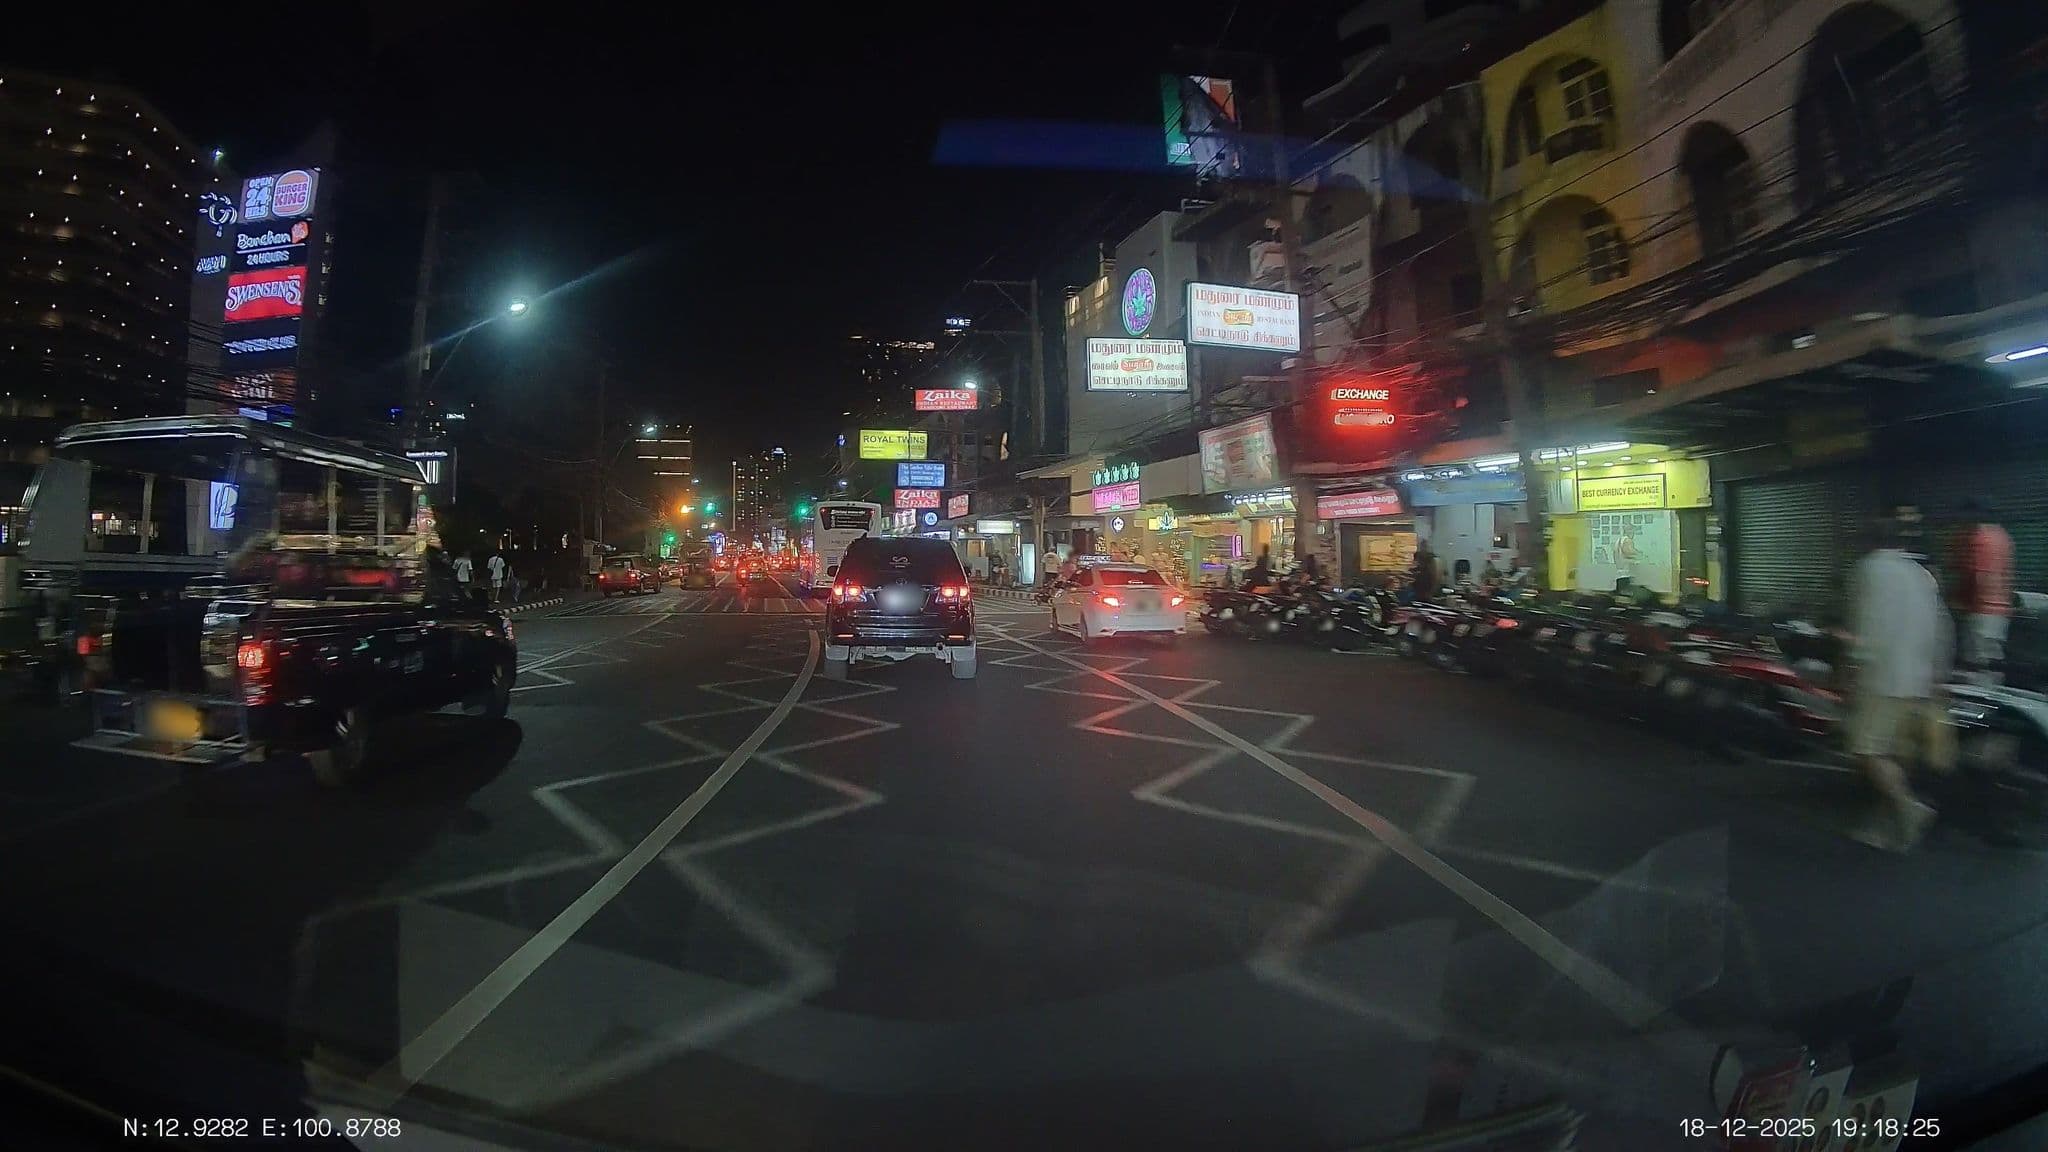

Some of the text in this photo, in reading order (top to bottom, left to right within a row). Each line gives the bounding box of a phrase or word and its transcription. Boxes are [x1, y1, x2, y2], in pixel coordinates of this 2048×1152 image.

[276, 183, 308, 194] BURGER
[245, 187, 272, 206] 24
[274, 192, 307, 206] KING
[225, 280, 301, 311] SWENSEN'S
[923, 390, 971, 401] Zaika
[1336, 388, 1389, 400] EXCHANGE
[863, 435, 926, 444] ROYAL TWINS
[899, 490, 938, 500] Zaika
[1582, 485, 1659, 498] BEST CURRENCY EXCHANGE
